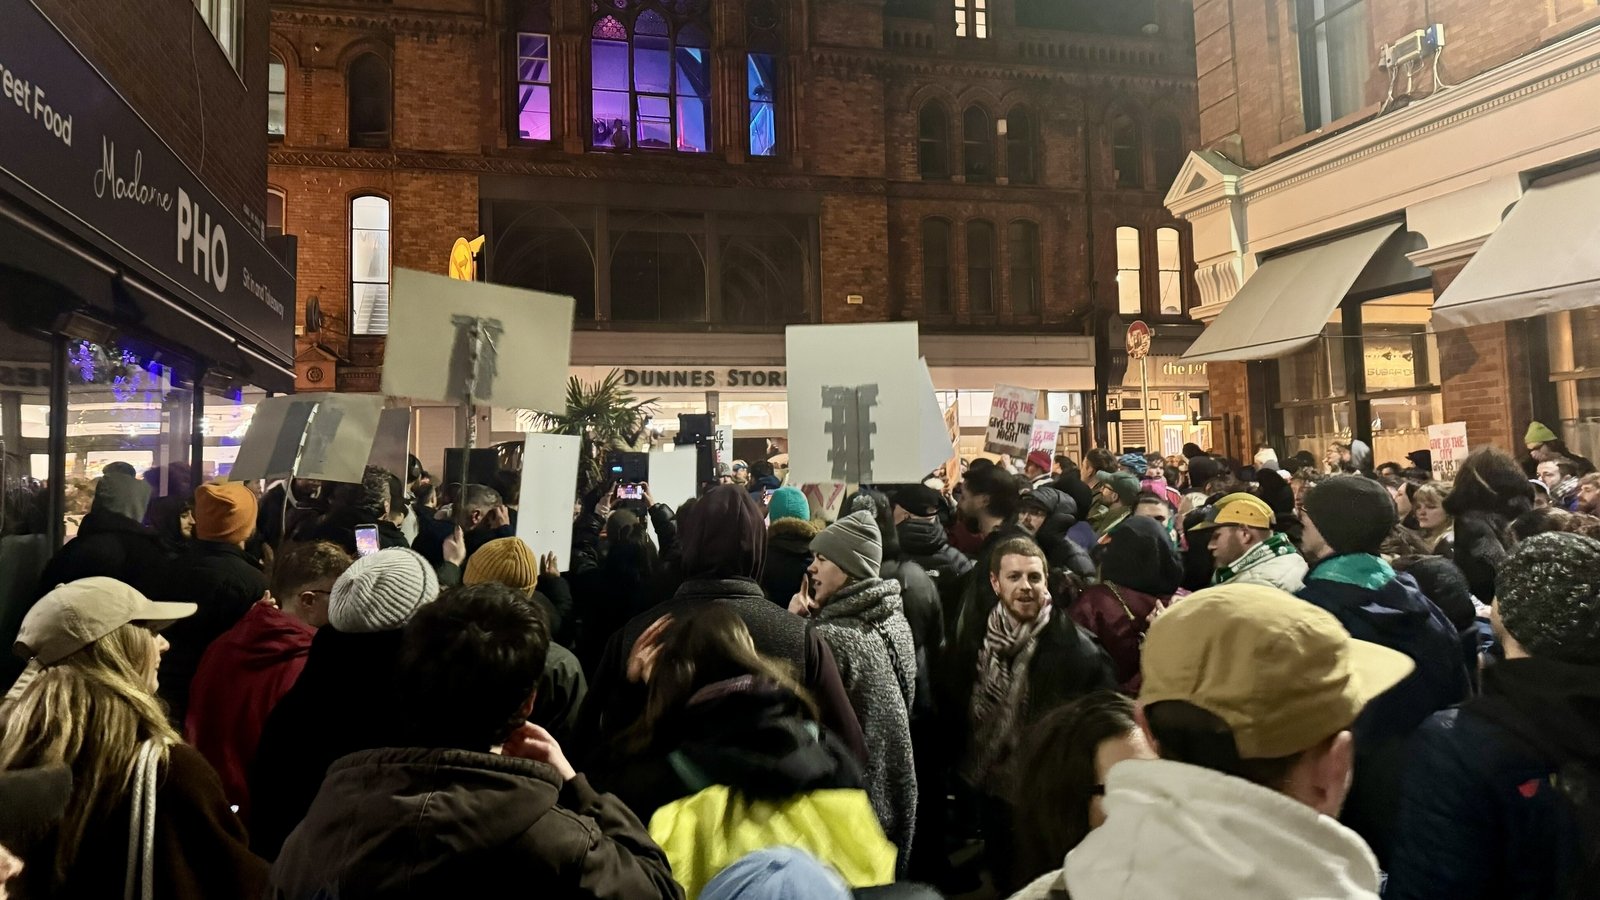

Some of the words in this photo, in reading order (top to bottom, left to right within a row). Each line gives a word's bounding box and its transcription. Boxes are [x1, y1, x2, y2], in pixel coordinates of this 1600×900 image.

[34, 85, 72, 147] Food
[177, 186, 229, 292] PHO
[1163, 362, 1185, 375] the
[624, 369, 716, 387] DUNNES
[992, 397, 1008, 409] GIVE
[1009, 400, 1019, 410] US
[1020, 402, 1034, 414] THE
[1002, 409, 1018, 421] CITY
[989, 417, 1005, 430] GIVE
[1006, 422, 1016, 432] US
[1017, 423, 1032, 435] THE
[997, 430, 1018, 443] NIGHT
[1033, 431, 1042, 441] US
[1043, 432, 1055, 441] THE
[1430, 439, 1441, 450] GIVE
[1442, 438, 1451, 448] US
[1451, 437, 1465, 448] THE
[1439, 448, 1453, 460] CITY
[1433, 460, 1444, 472] GIVE
[1444, 460, 1454, 471] US
